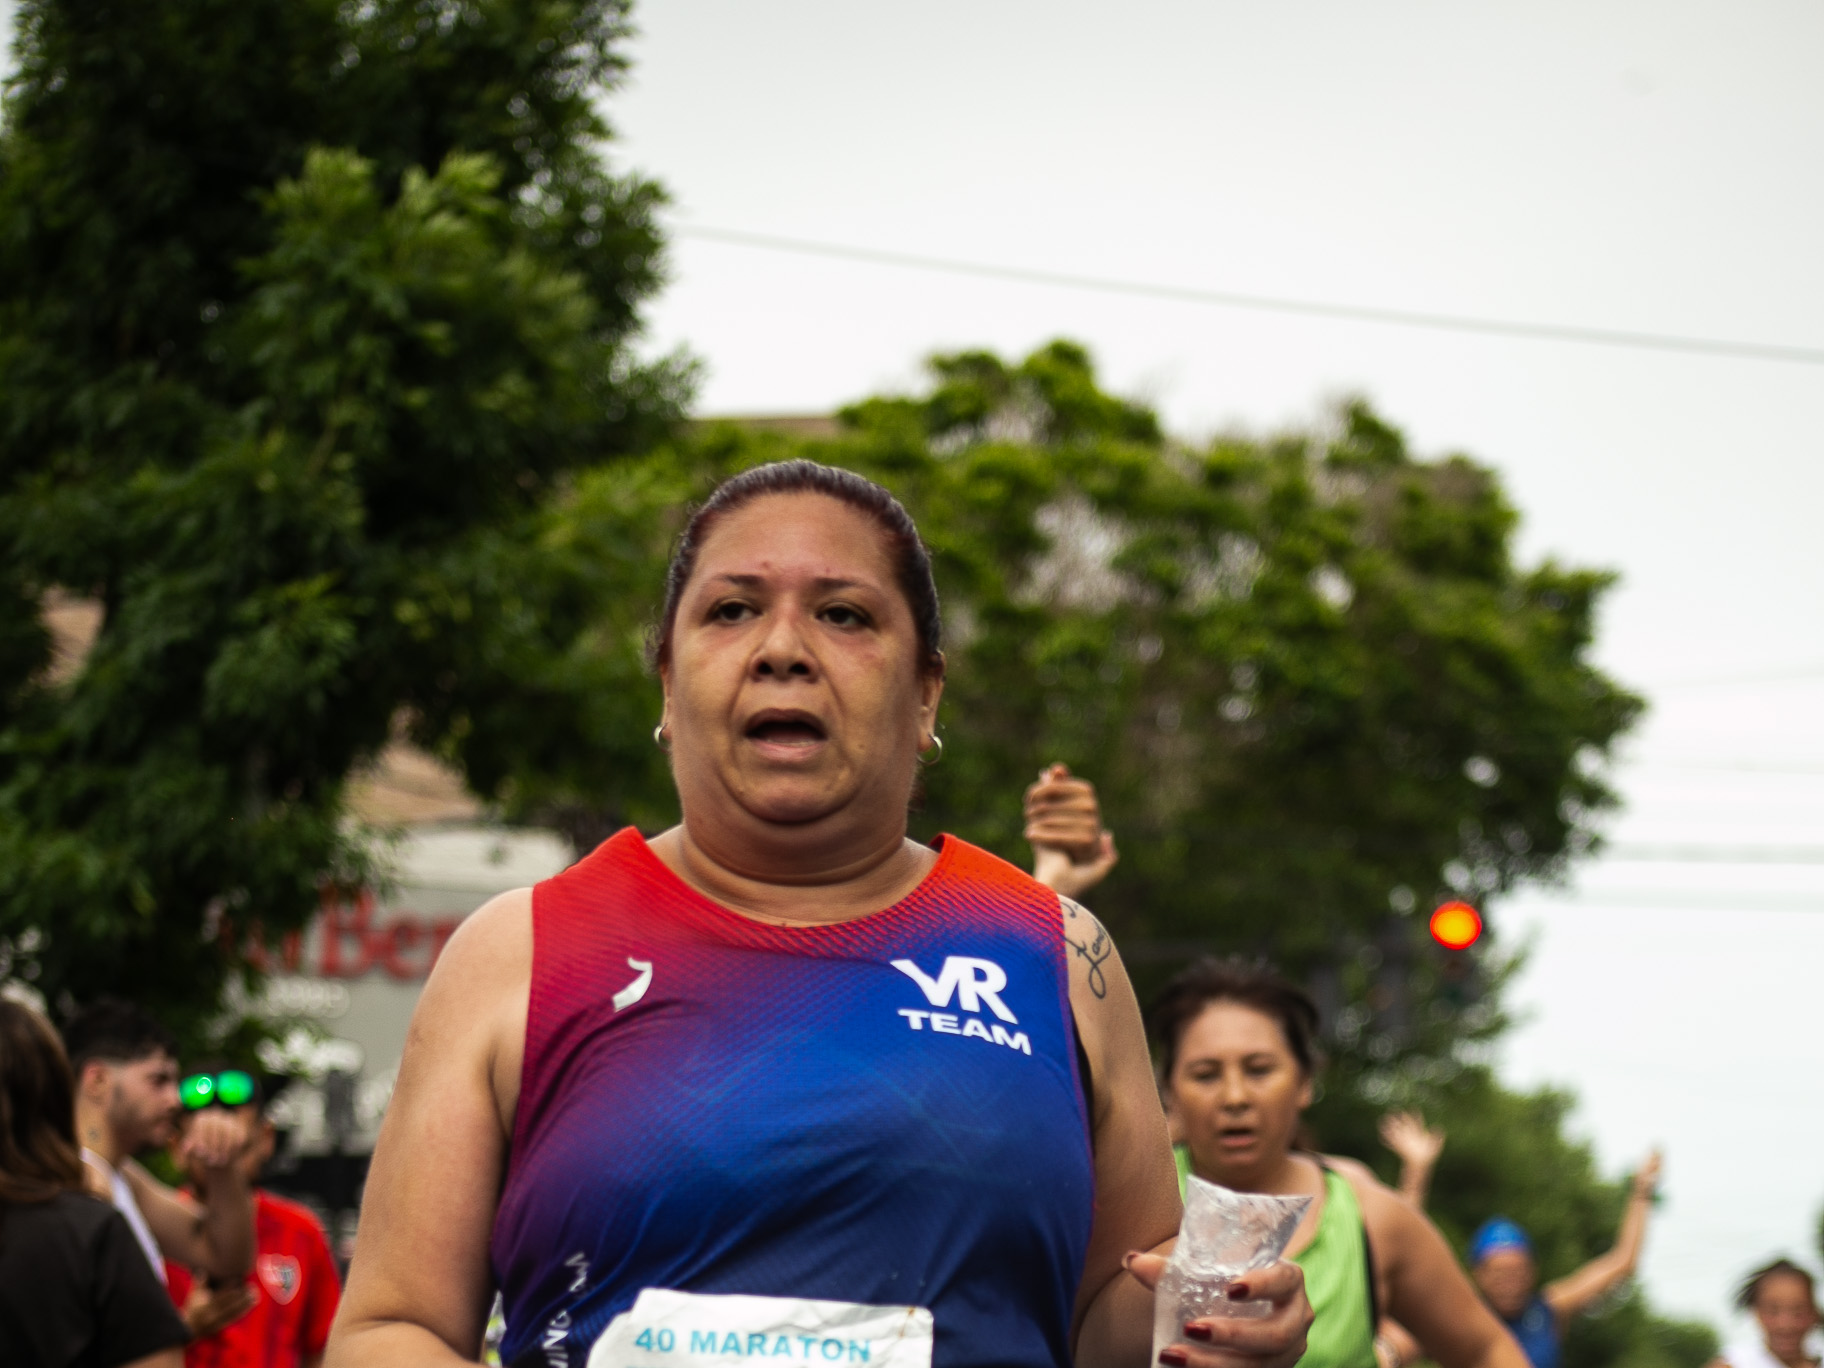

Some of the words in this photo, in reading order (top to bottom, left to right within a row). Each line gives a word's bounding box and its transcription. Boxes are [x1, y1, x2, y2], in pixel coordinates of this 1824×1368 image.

[889, 955, 1019, 1026] VR
[897, 1008, 1032, 1057] TEAM
[635, 1327, 676, 1353] 40
[690, 1330, 872, 1363] MARATON
